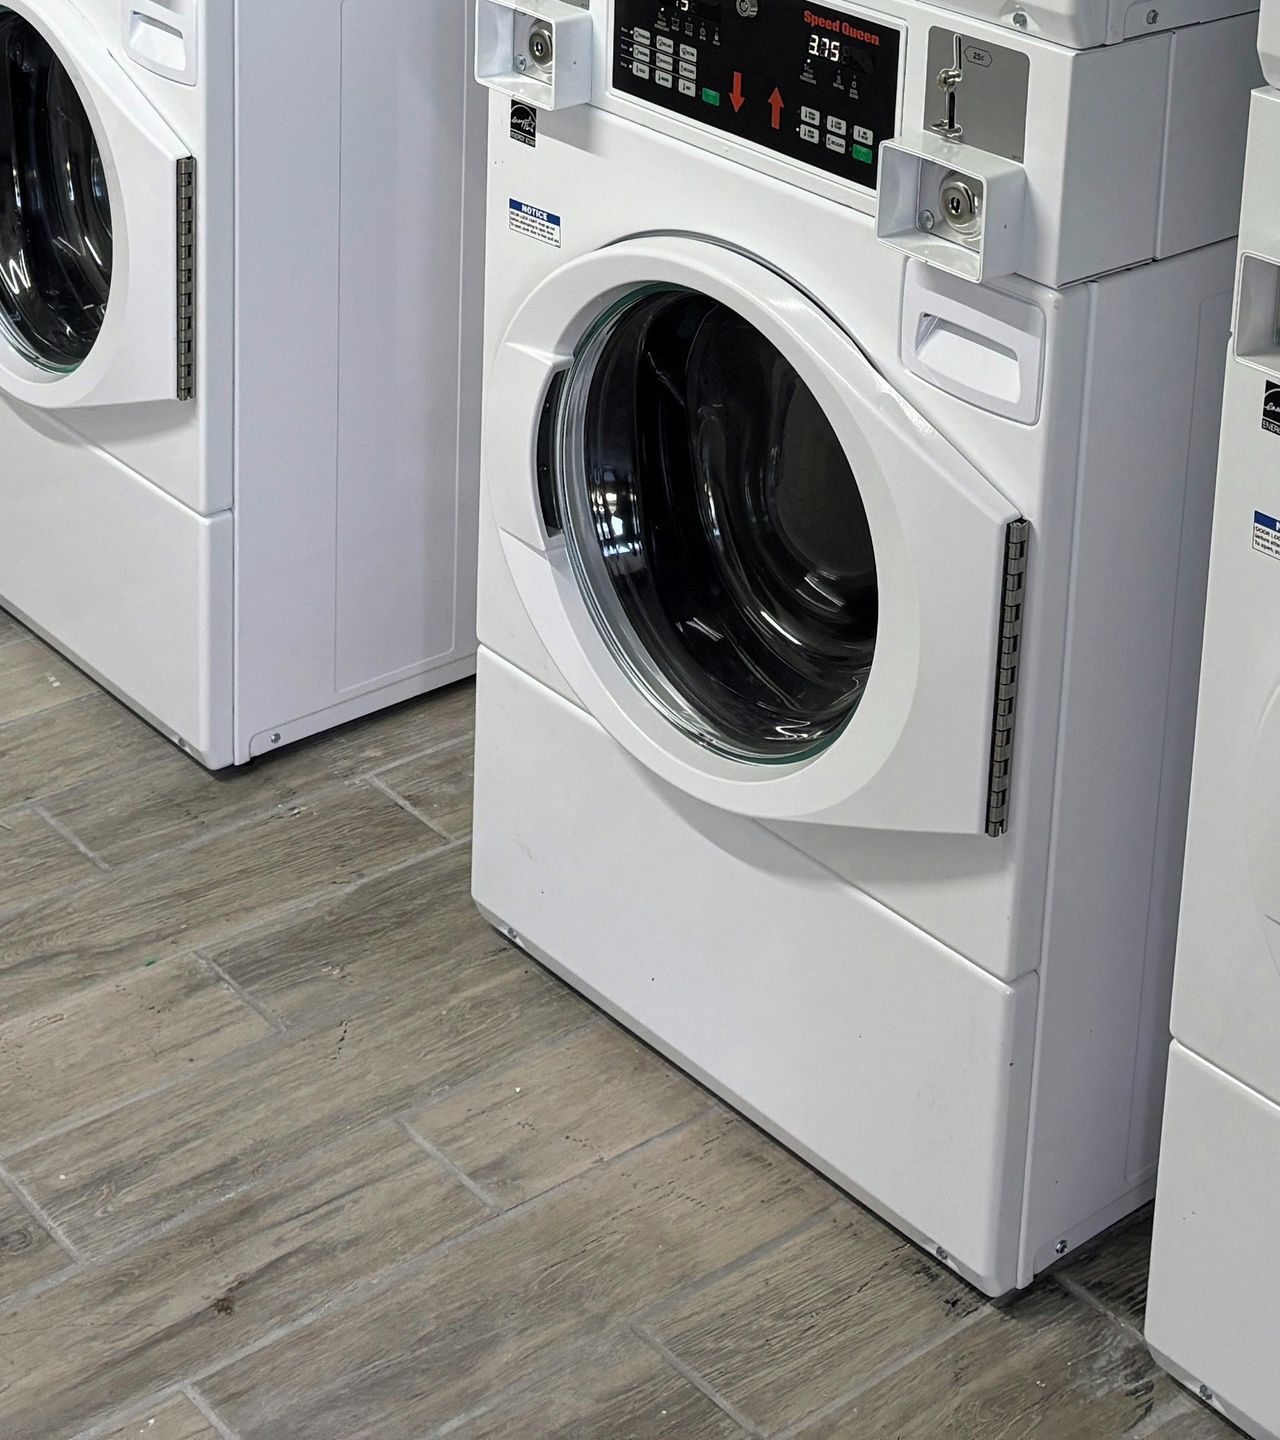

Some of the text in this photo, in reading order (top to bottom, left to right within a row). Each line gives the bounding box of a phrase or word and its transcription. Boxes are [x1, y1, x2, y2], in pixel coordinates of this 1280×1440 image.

[803, 10, 880, 46] Speed Queen
[521, 204, 548, 221] NOTICE
